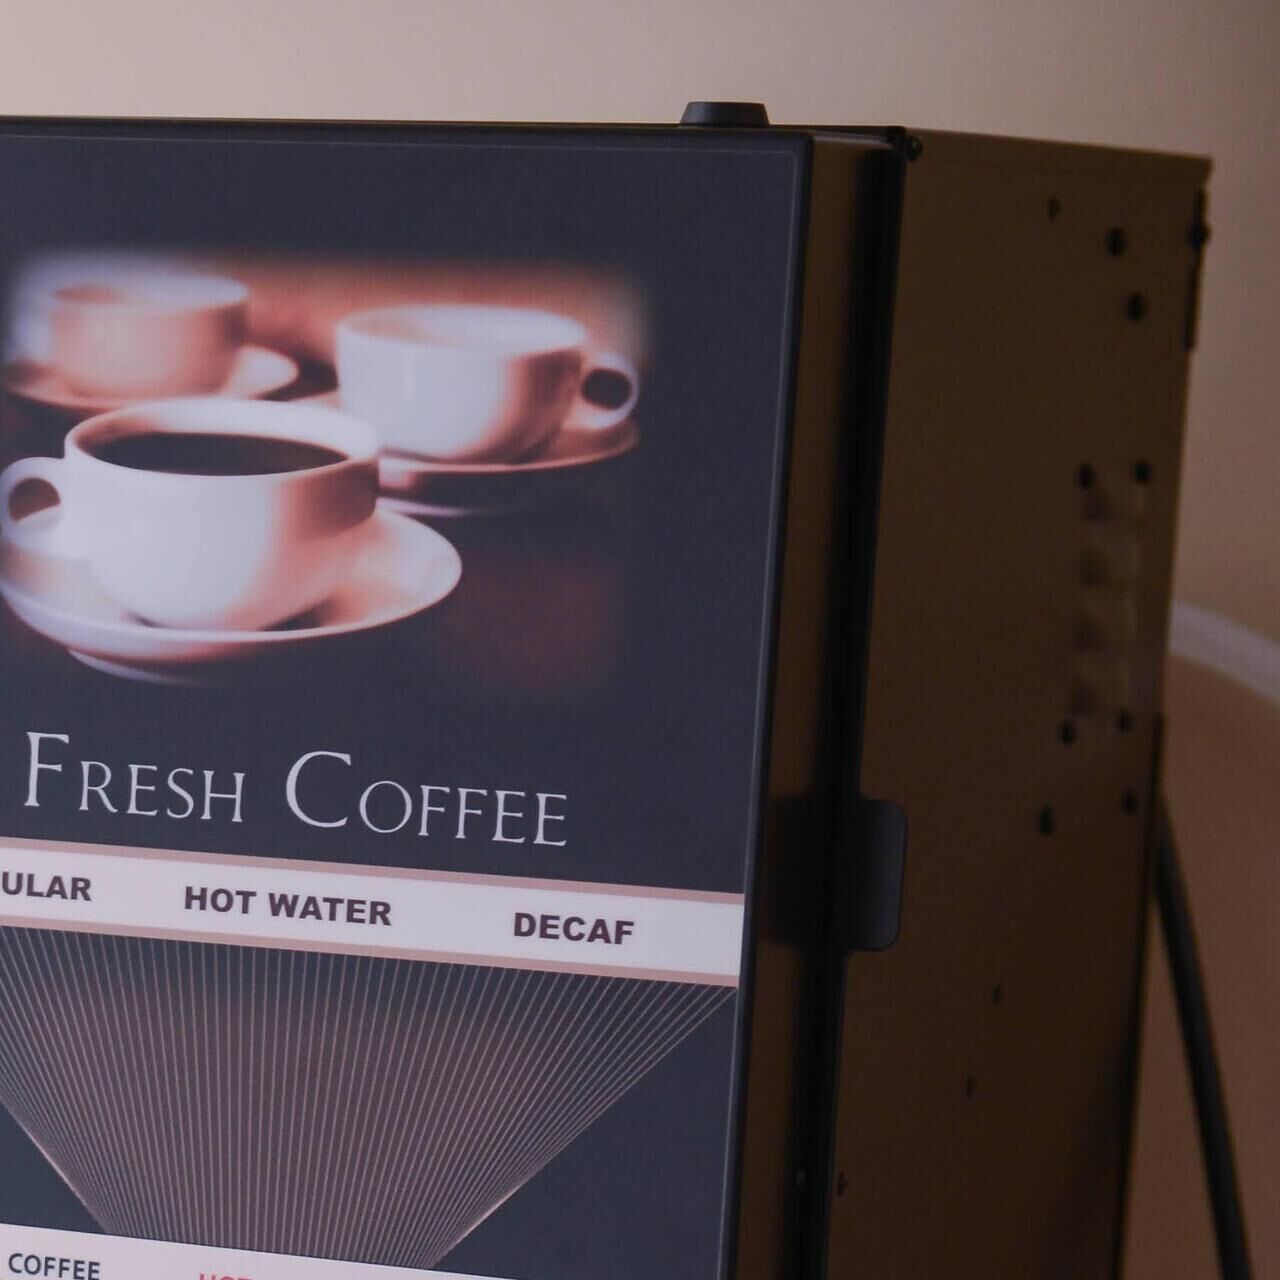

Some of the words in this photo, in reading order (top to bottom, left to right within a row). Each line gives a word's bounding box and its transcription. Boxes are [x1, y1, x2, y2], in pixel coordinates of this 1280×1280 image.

[24, 731, 245, 822] FRESH
[285, 750, 568, 847] COFFEE
[184, 886, 256, 914] HOT
[268, 892, 392, 926] WATER
[513, 912, 635, 945] DECAF
